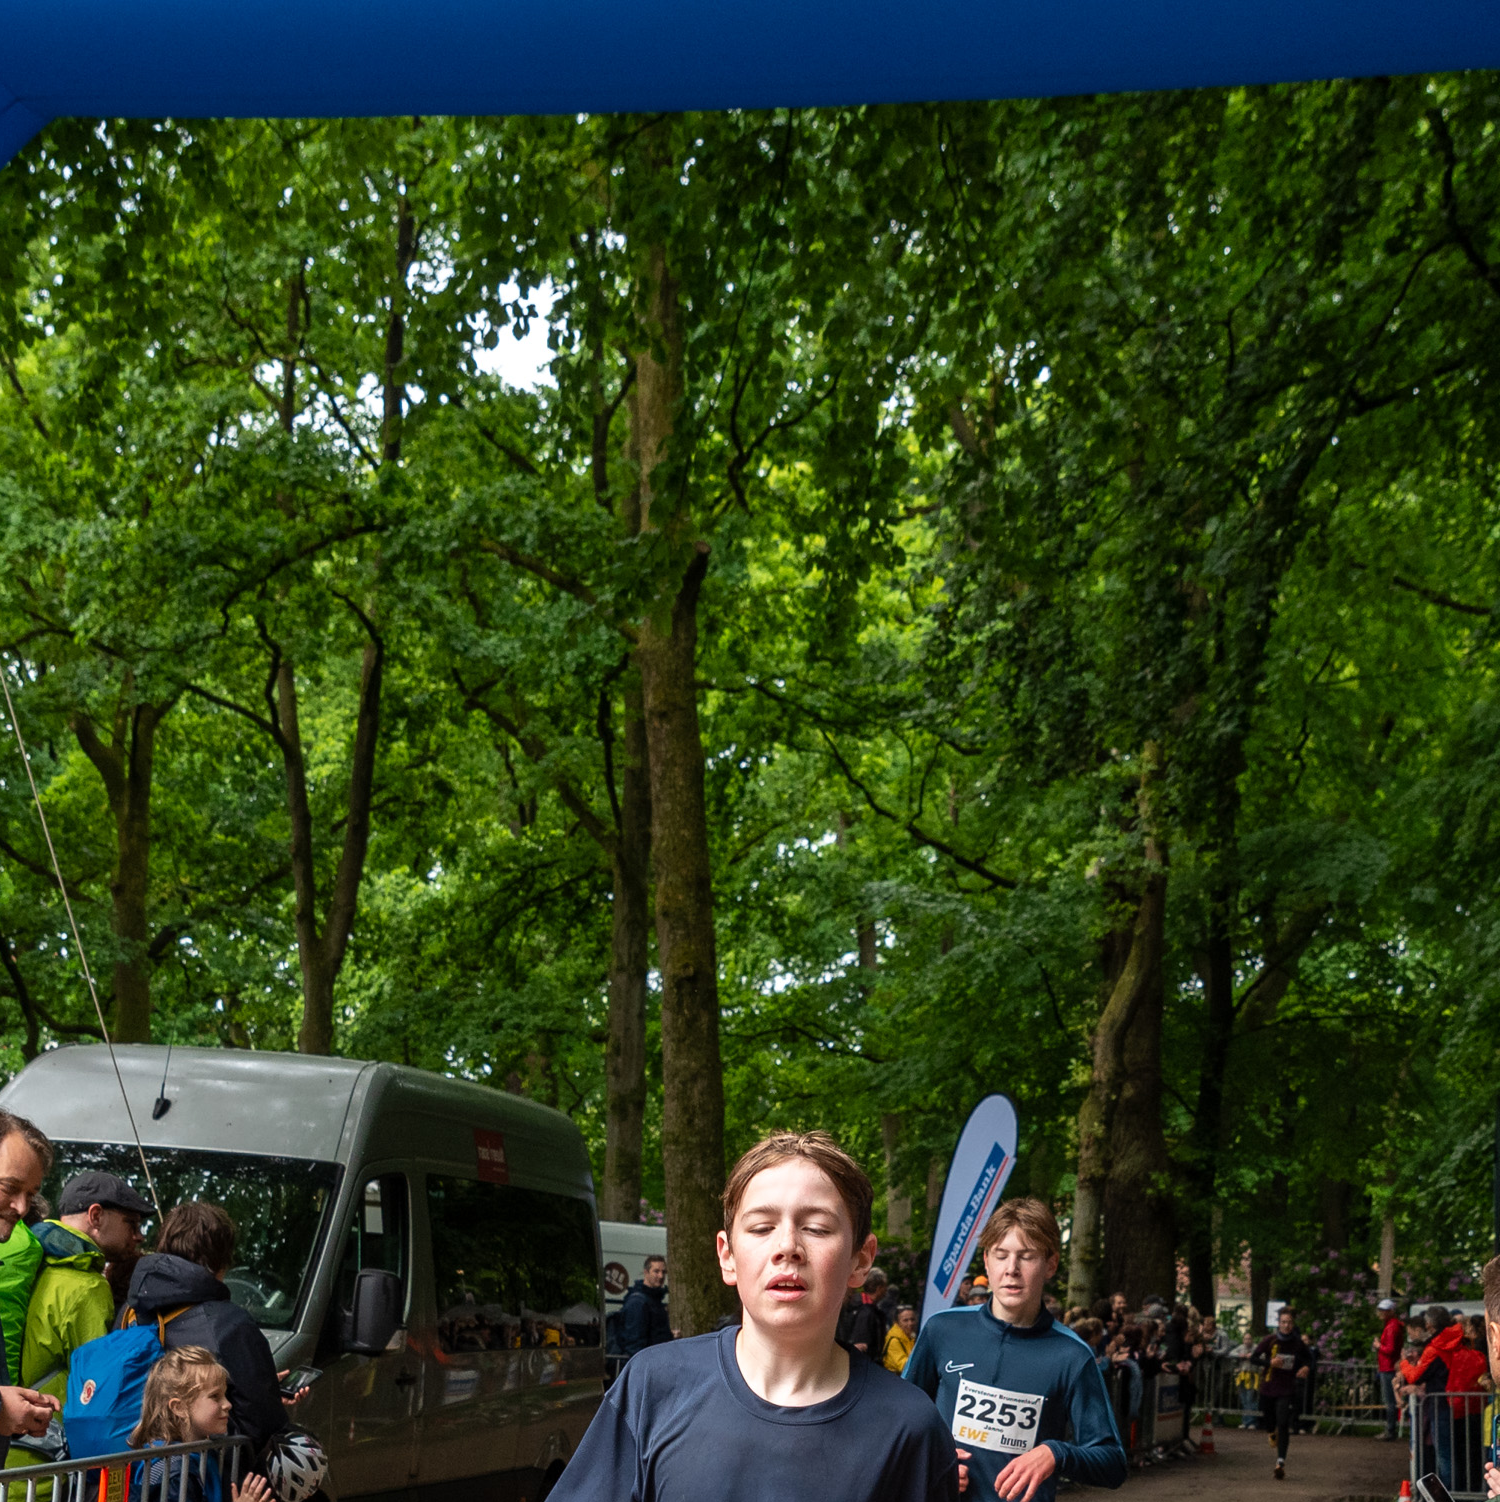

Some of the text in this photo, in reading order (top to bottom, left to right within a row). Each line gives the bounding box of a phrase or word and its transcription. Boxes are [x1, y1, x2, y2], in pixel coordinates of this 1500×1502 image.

[943, 1163, 996, 1276] Sparda-Bank
[957, 1394, 1037, 1430] 2253
[959, 1426, 989, 1443] EWE
[1000, 1434, 1027, 1448] bruns
